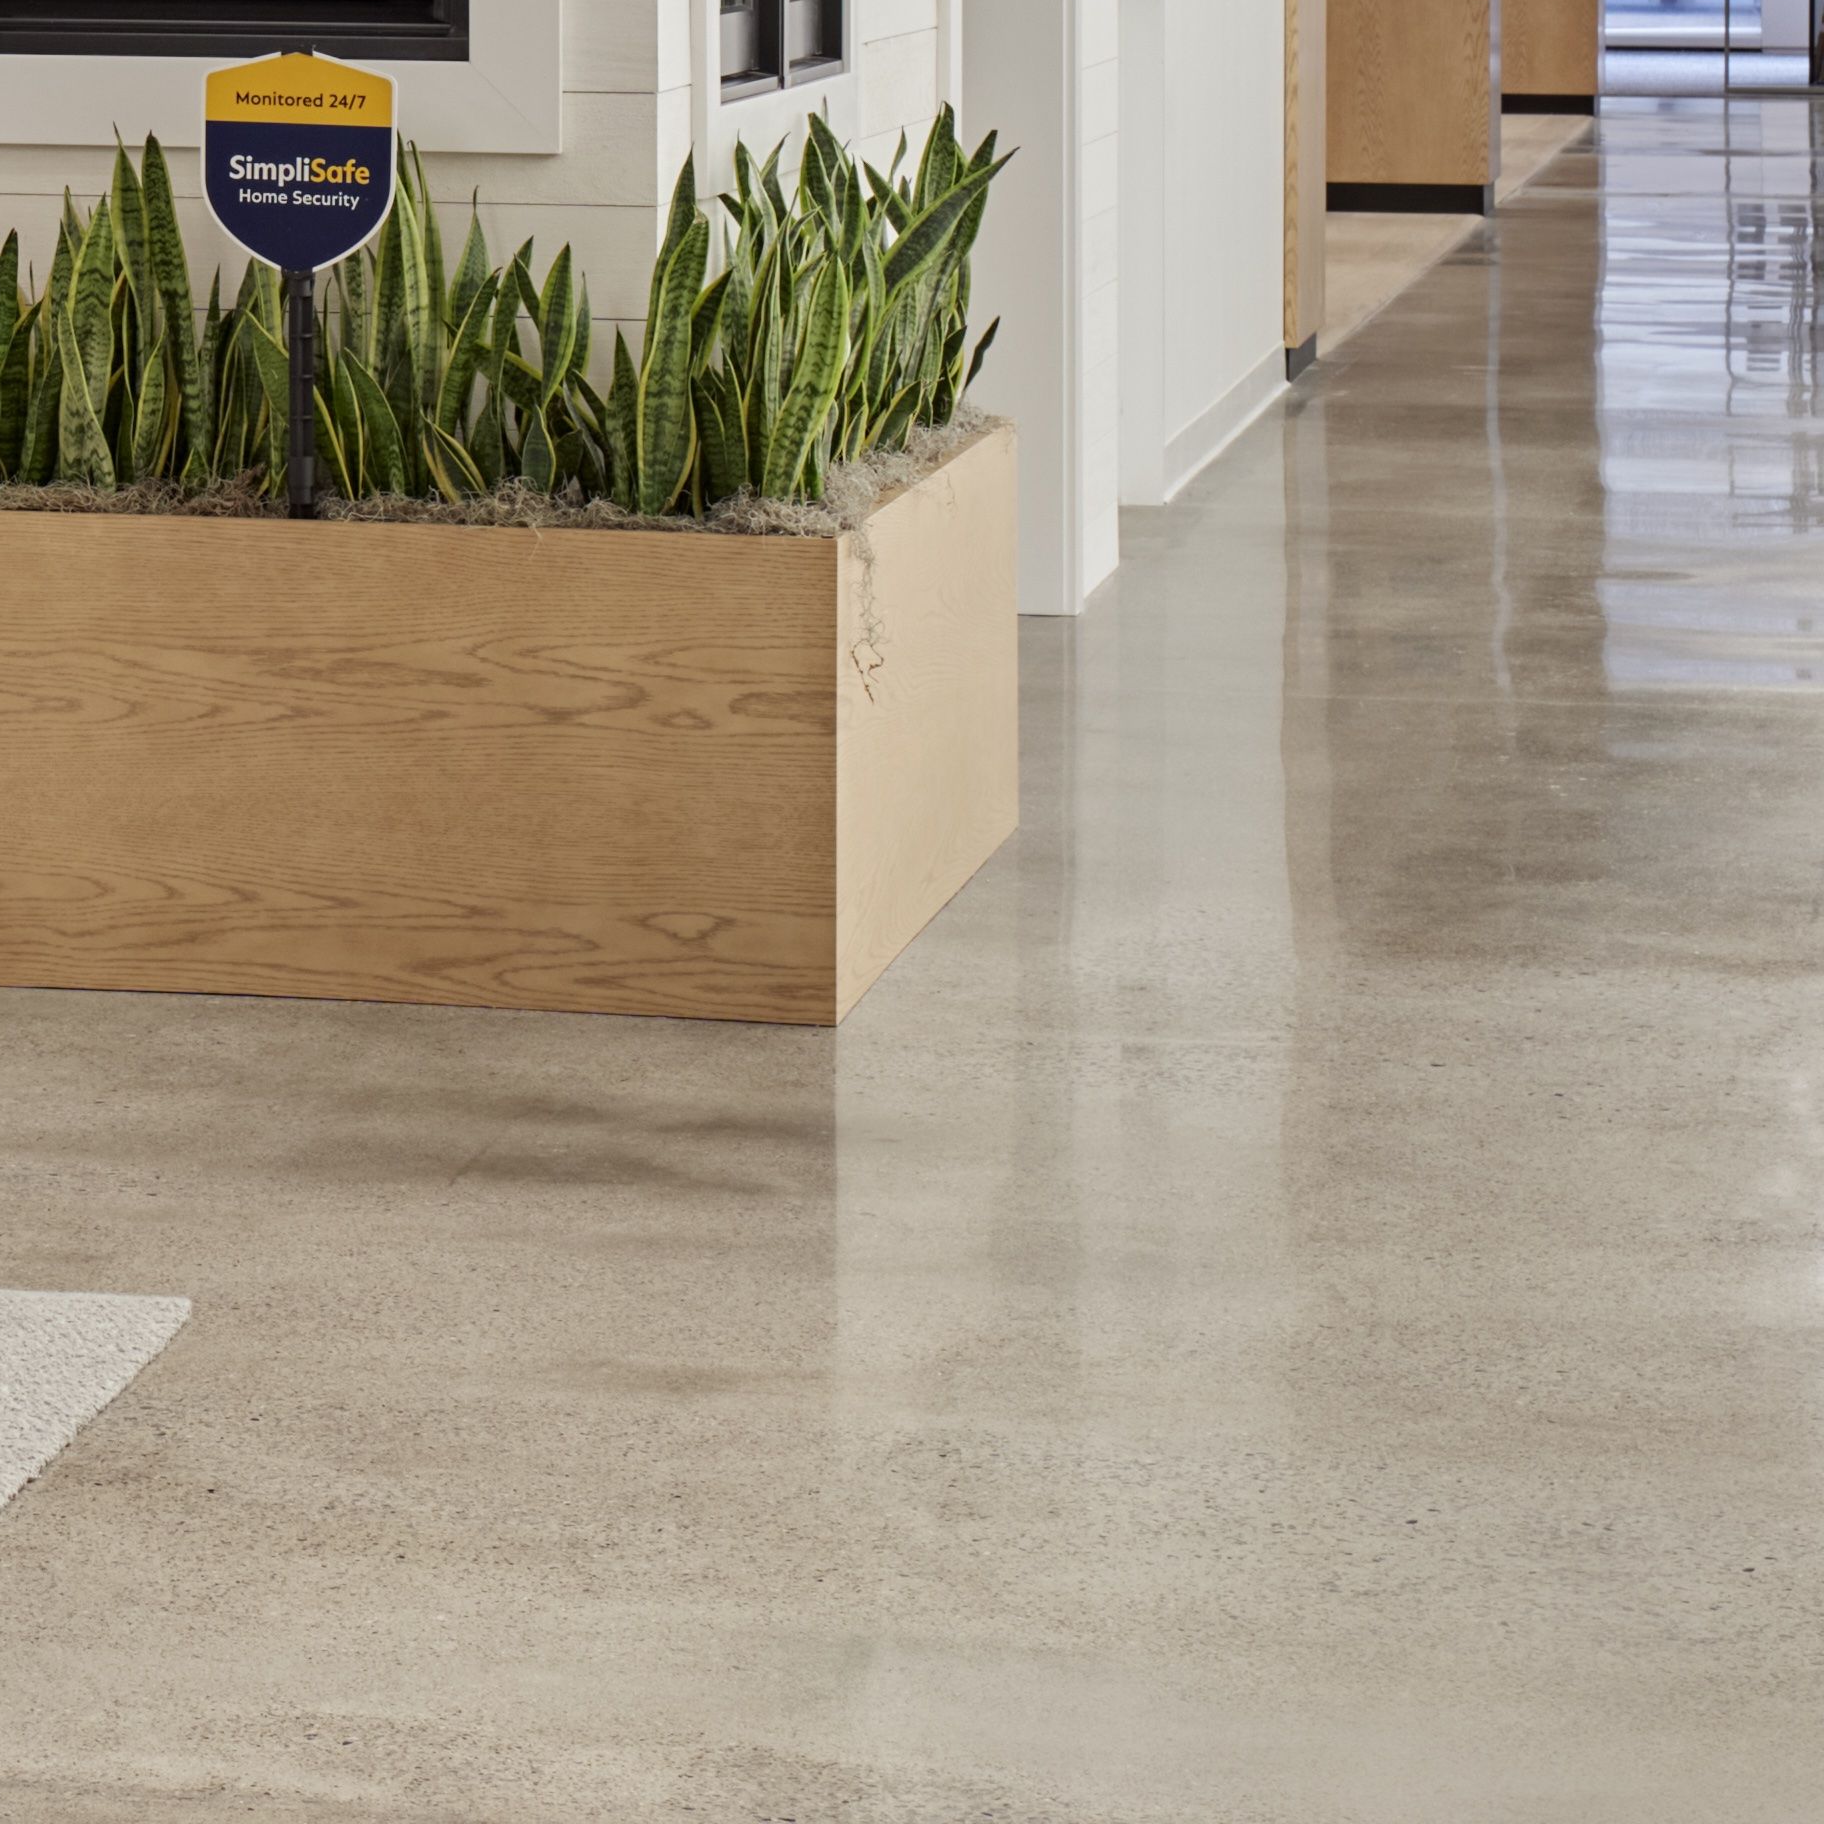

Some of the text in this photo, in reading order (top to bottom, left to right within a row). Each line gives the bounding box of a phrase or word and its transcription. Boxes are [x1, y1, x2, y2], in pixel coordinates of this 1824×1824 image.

[235, 91, 367, 110] Monitored 24/7
[228, 154, 371, 188] SimpliSafe
[238, 188, 360, 211] Home Security
